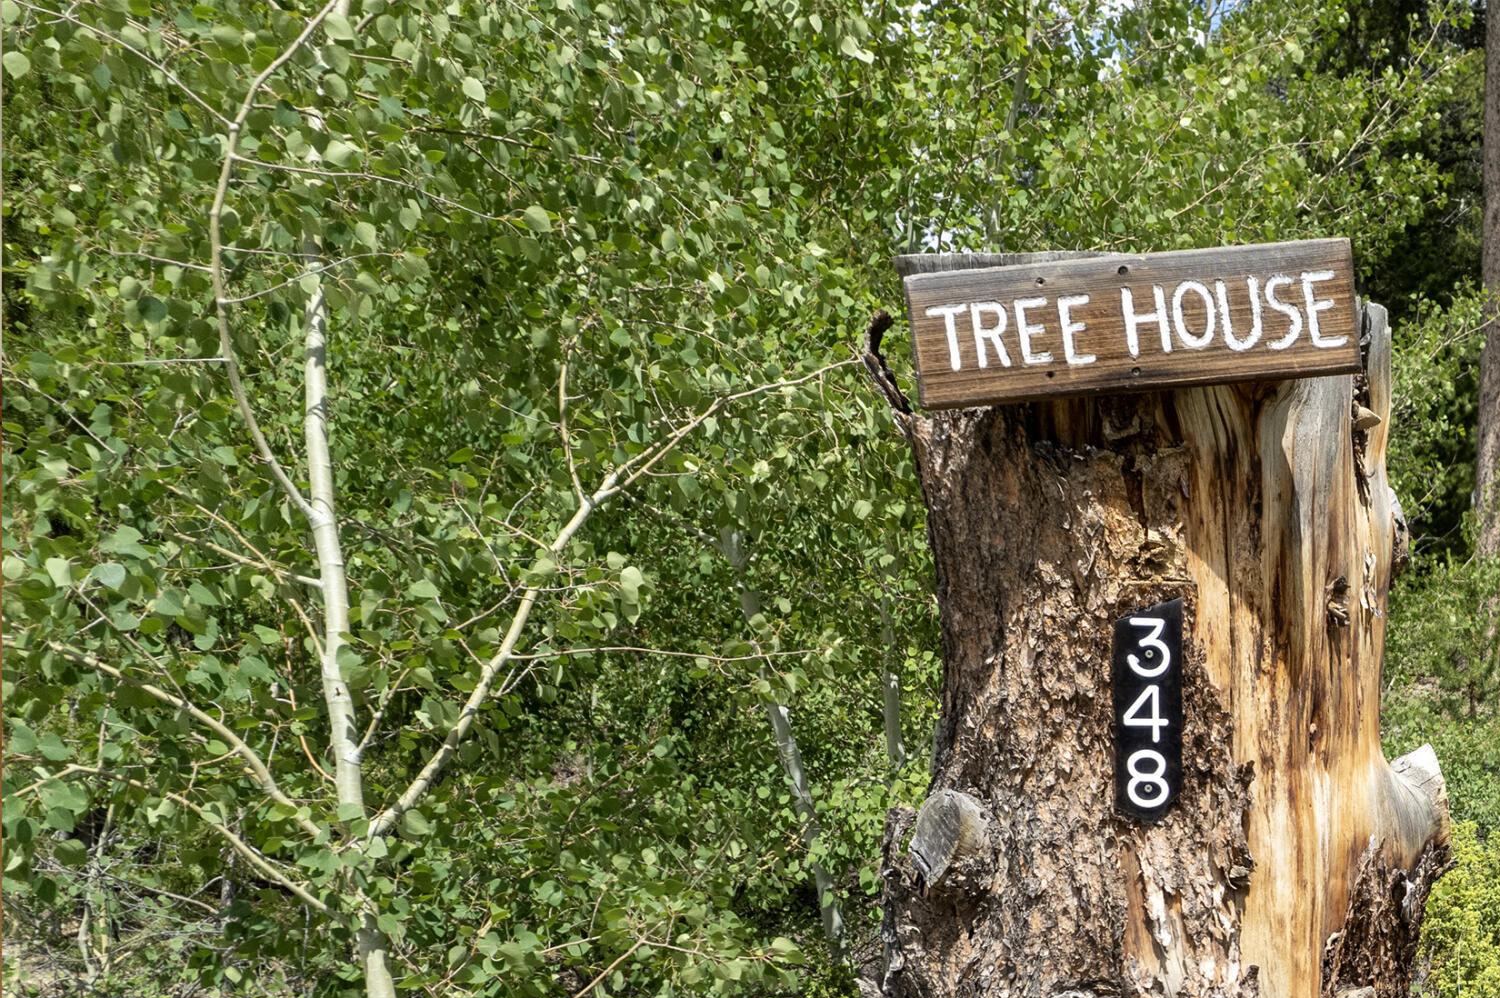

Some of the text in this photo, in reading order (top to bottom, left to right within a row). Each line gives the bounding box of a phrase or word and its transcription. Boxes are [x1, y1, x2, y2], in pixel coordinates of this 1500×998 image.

[925, 269, 1349, 371] TREE HOUSE
[1123, 617, 1171, 808] 348
